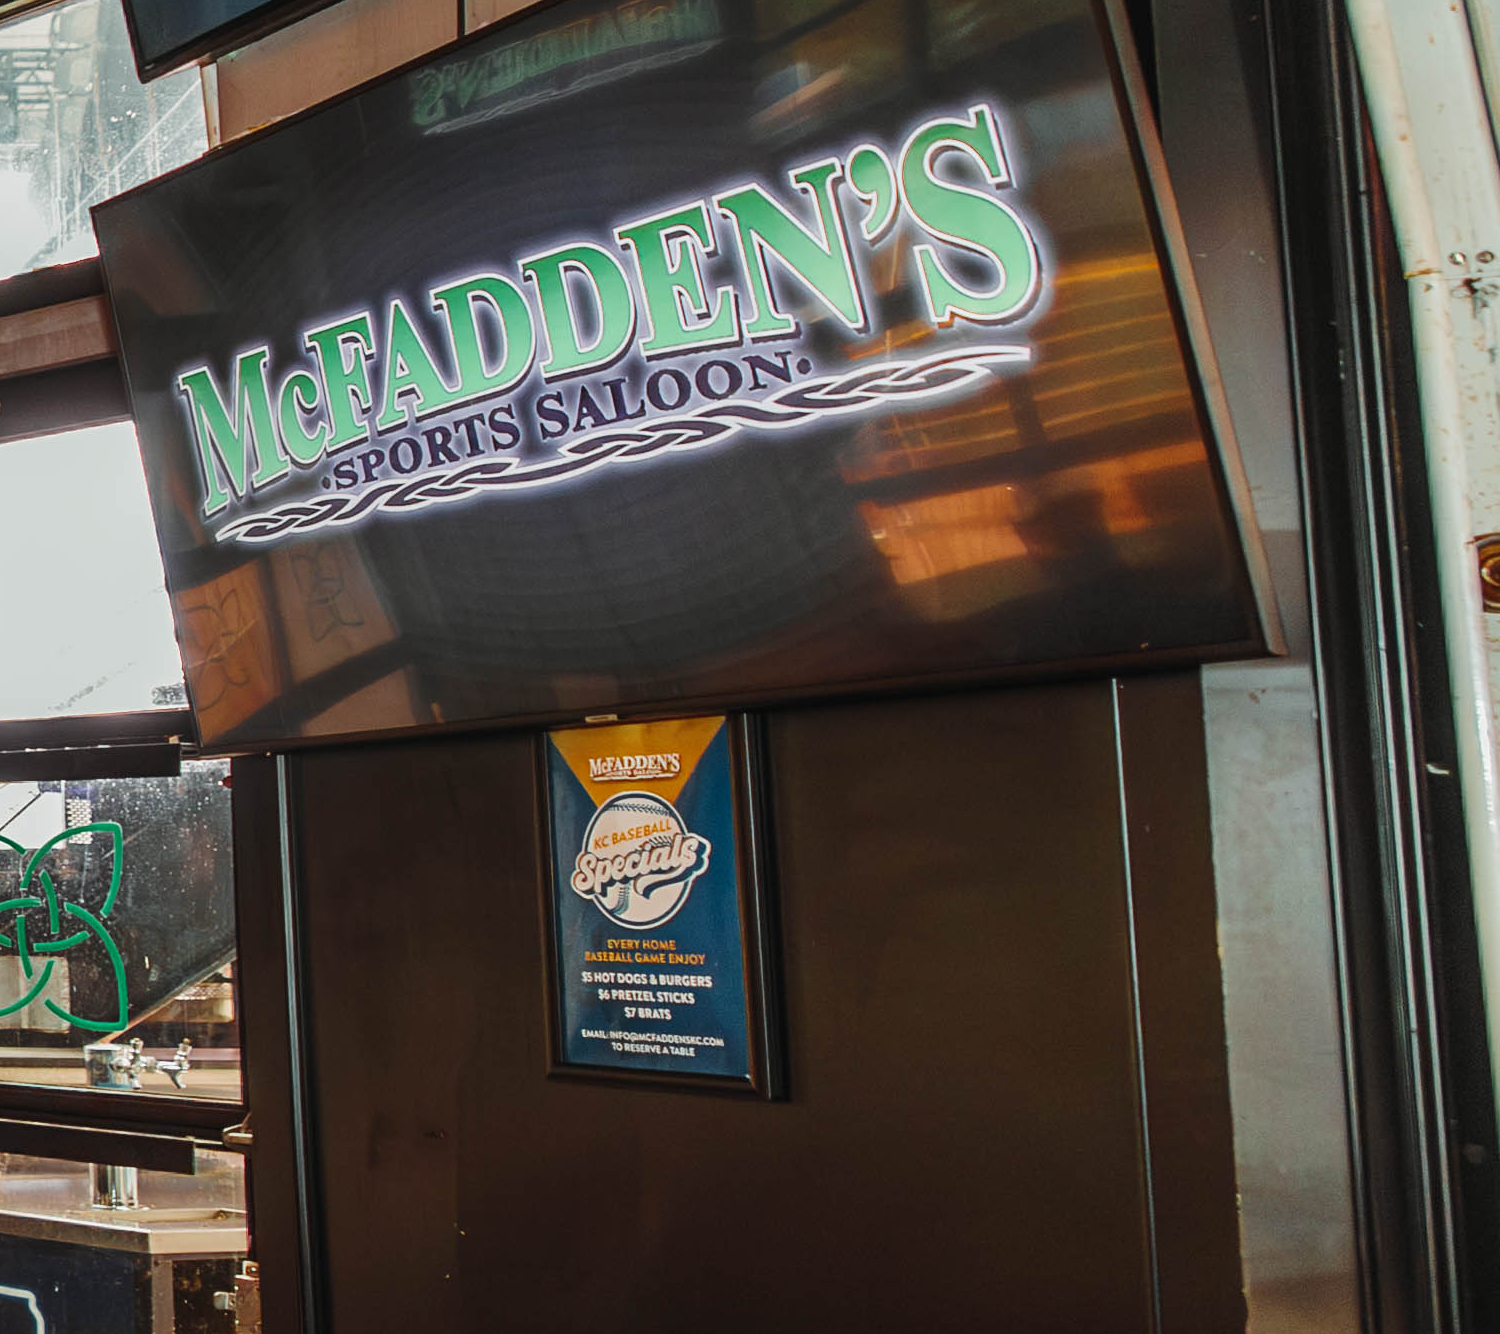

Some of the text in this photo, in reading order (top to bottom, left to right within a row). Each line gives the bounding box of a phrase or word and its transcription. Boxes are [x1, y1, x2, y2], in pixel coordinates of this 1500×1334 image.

[176, 101, 1043, 517] McFADDEN'S
[332, 349, 794, 491] SPORTS SALOON
[588, 752, 681, 778] McFADDEN'S
[594, 818, 672, 850] KC BASEBALL
[572, 833, 700, 894] Specials
[607, 939, 676, 951] EVERY HOME
[584, 951, 705, 965] BASEBALL GAME ENJOY
[594, 972, 615, 983] HOT
[617, 973, 647, 985] DOGS
[649, 974, 657, 986] &
[659, 975, 713, 988] BURGERS
[598, 989, 695, 1005] $6 PRETZEL STICKS
[624, 1007, 672, 1020] $7 BRATS
[612, 1042, 696, 1057] TO RESERVE A TABLE
